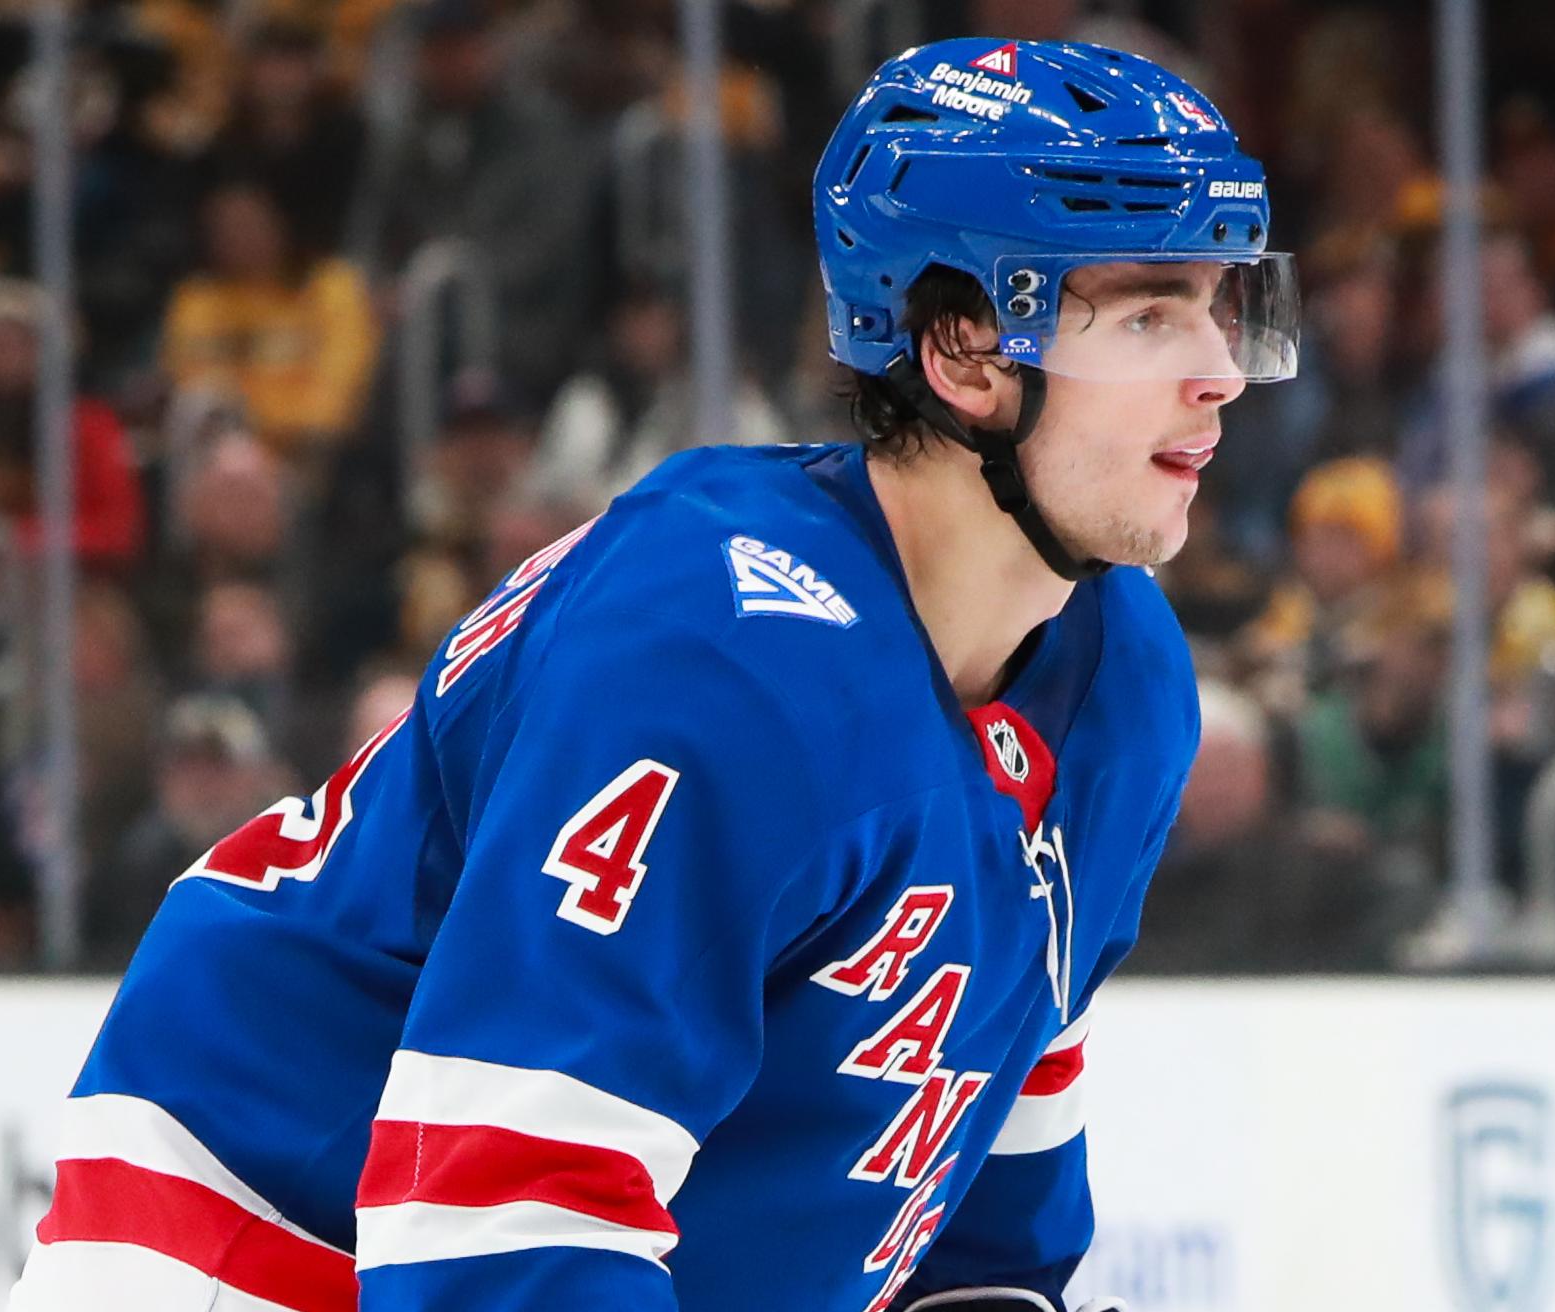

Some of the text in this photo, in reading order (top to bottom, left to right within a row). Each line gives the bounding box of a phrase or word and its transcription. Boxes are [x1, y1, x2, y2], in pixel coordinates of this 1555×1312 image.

[929, 62, 1033, 105] Benjamin
[931, 84, 1005, 121] Moore
[1208, 181, 1263, 199] BAUER
[730, 536, 858, 625] GAME
[542, 758, 681, 936] 4
